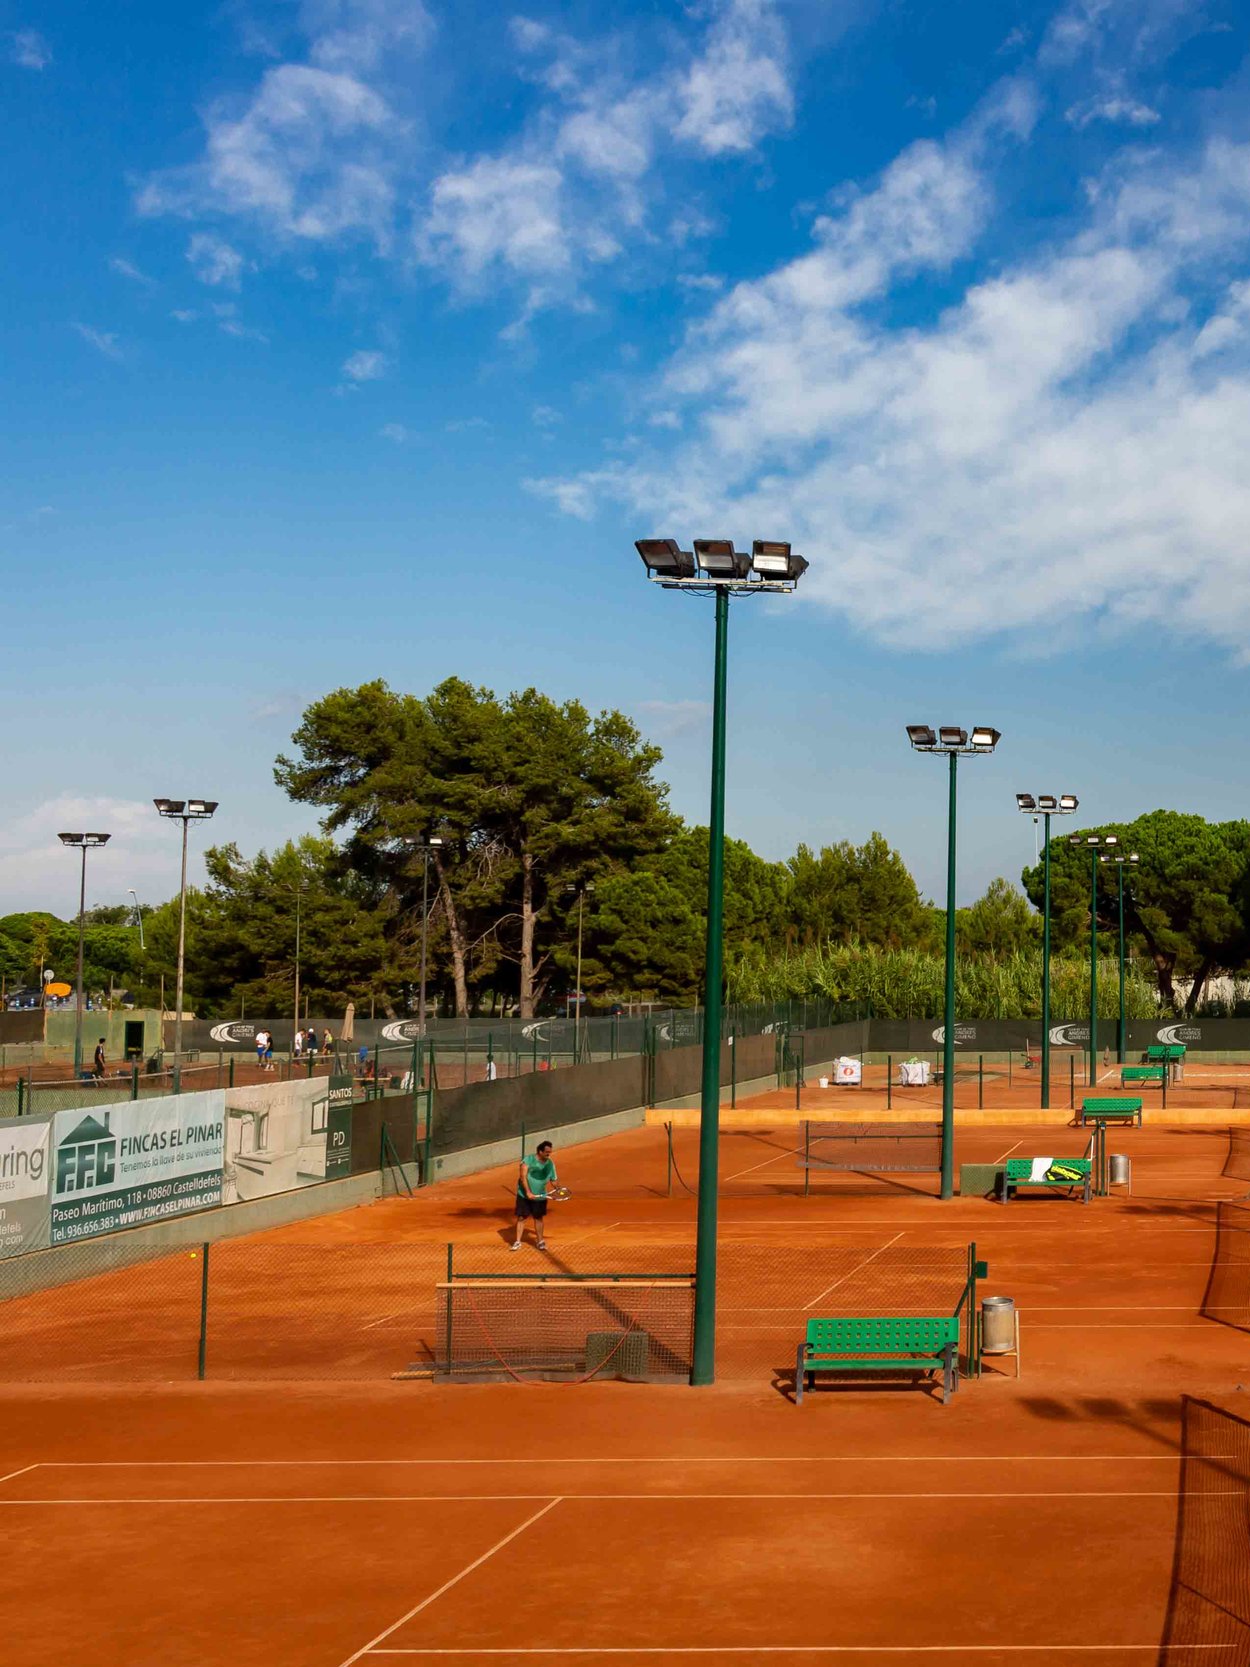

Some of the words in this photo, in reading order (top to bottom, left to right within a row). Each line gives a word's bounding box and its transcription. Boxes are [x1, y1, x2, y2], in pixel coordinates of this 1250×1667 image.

[329, 1087, 352, 1100] SANTOS
[120, 1131, 167, 1157] FINCAS
[169, 1128, 183, 1147] EL
[186, 1122, 223, 1144] PINAR
[333, 1131, 345, 1146] PD
[0, 1145, 44, 1181] ring
[120, 1162, 152, 1173] Tenemos
[160, 1154, 175, 1166] llave
[176, 1152, 185, 1161] de
[52, 1207, 80, 1223] Paseo
[81, 1197, 125, 1217] Marítimo,
[127, 1191, 142, 1206] 118
[147, 1184, 172, 1201] 08860
[173, 1173, 221, 1194] Castelldefels
[52, 1226, 67, 1242] Tel.
[67, 1216, 115, 1238] 936.656.383
[119, 1191, 220, 1225] WWW.FINCASELPINAR.COM
